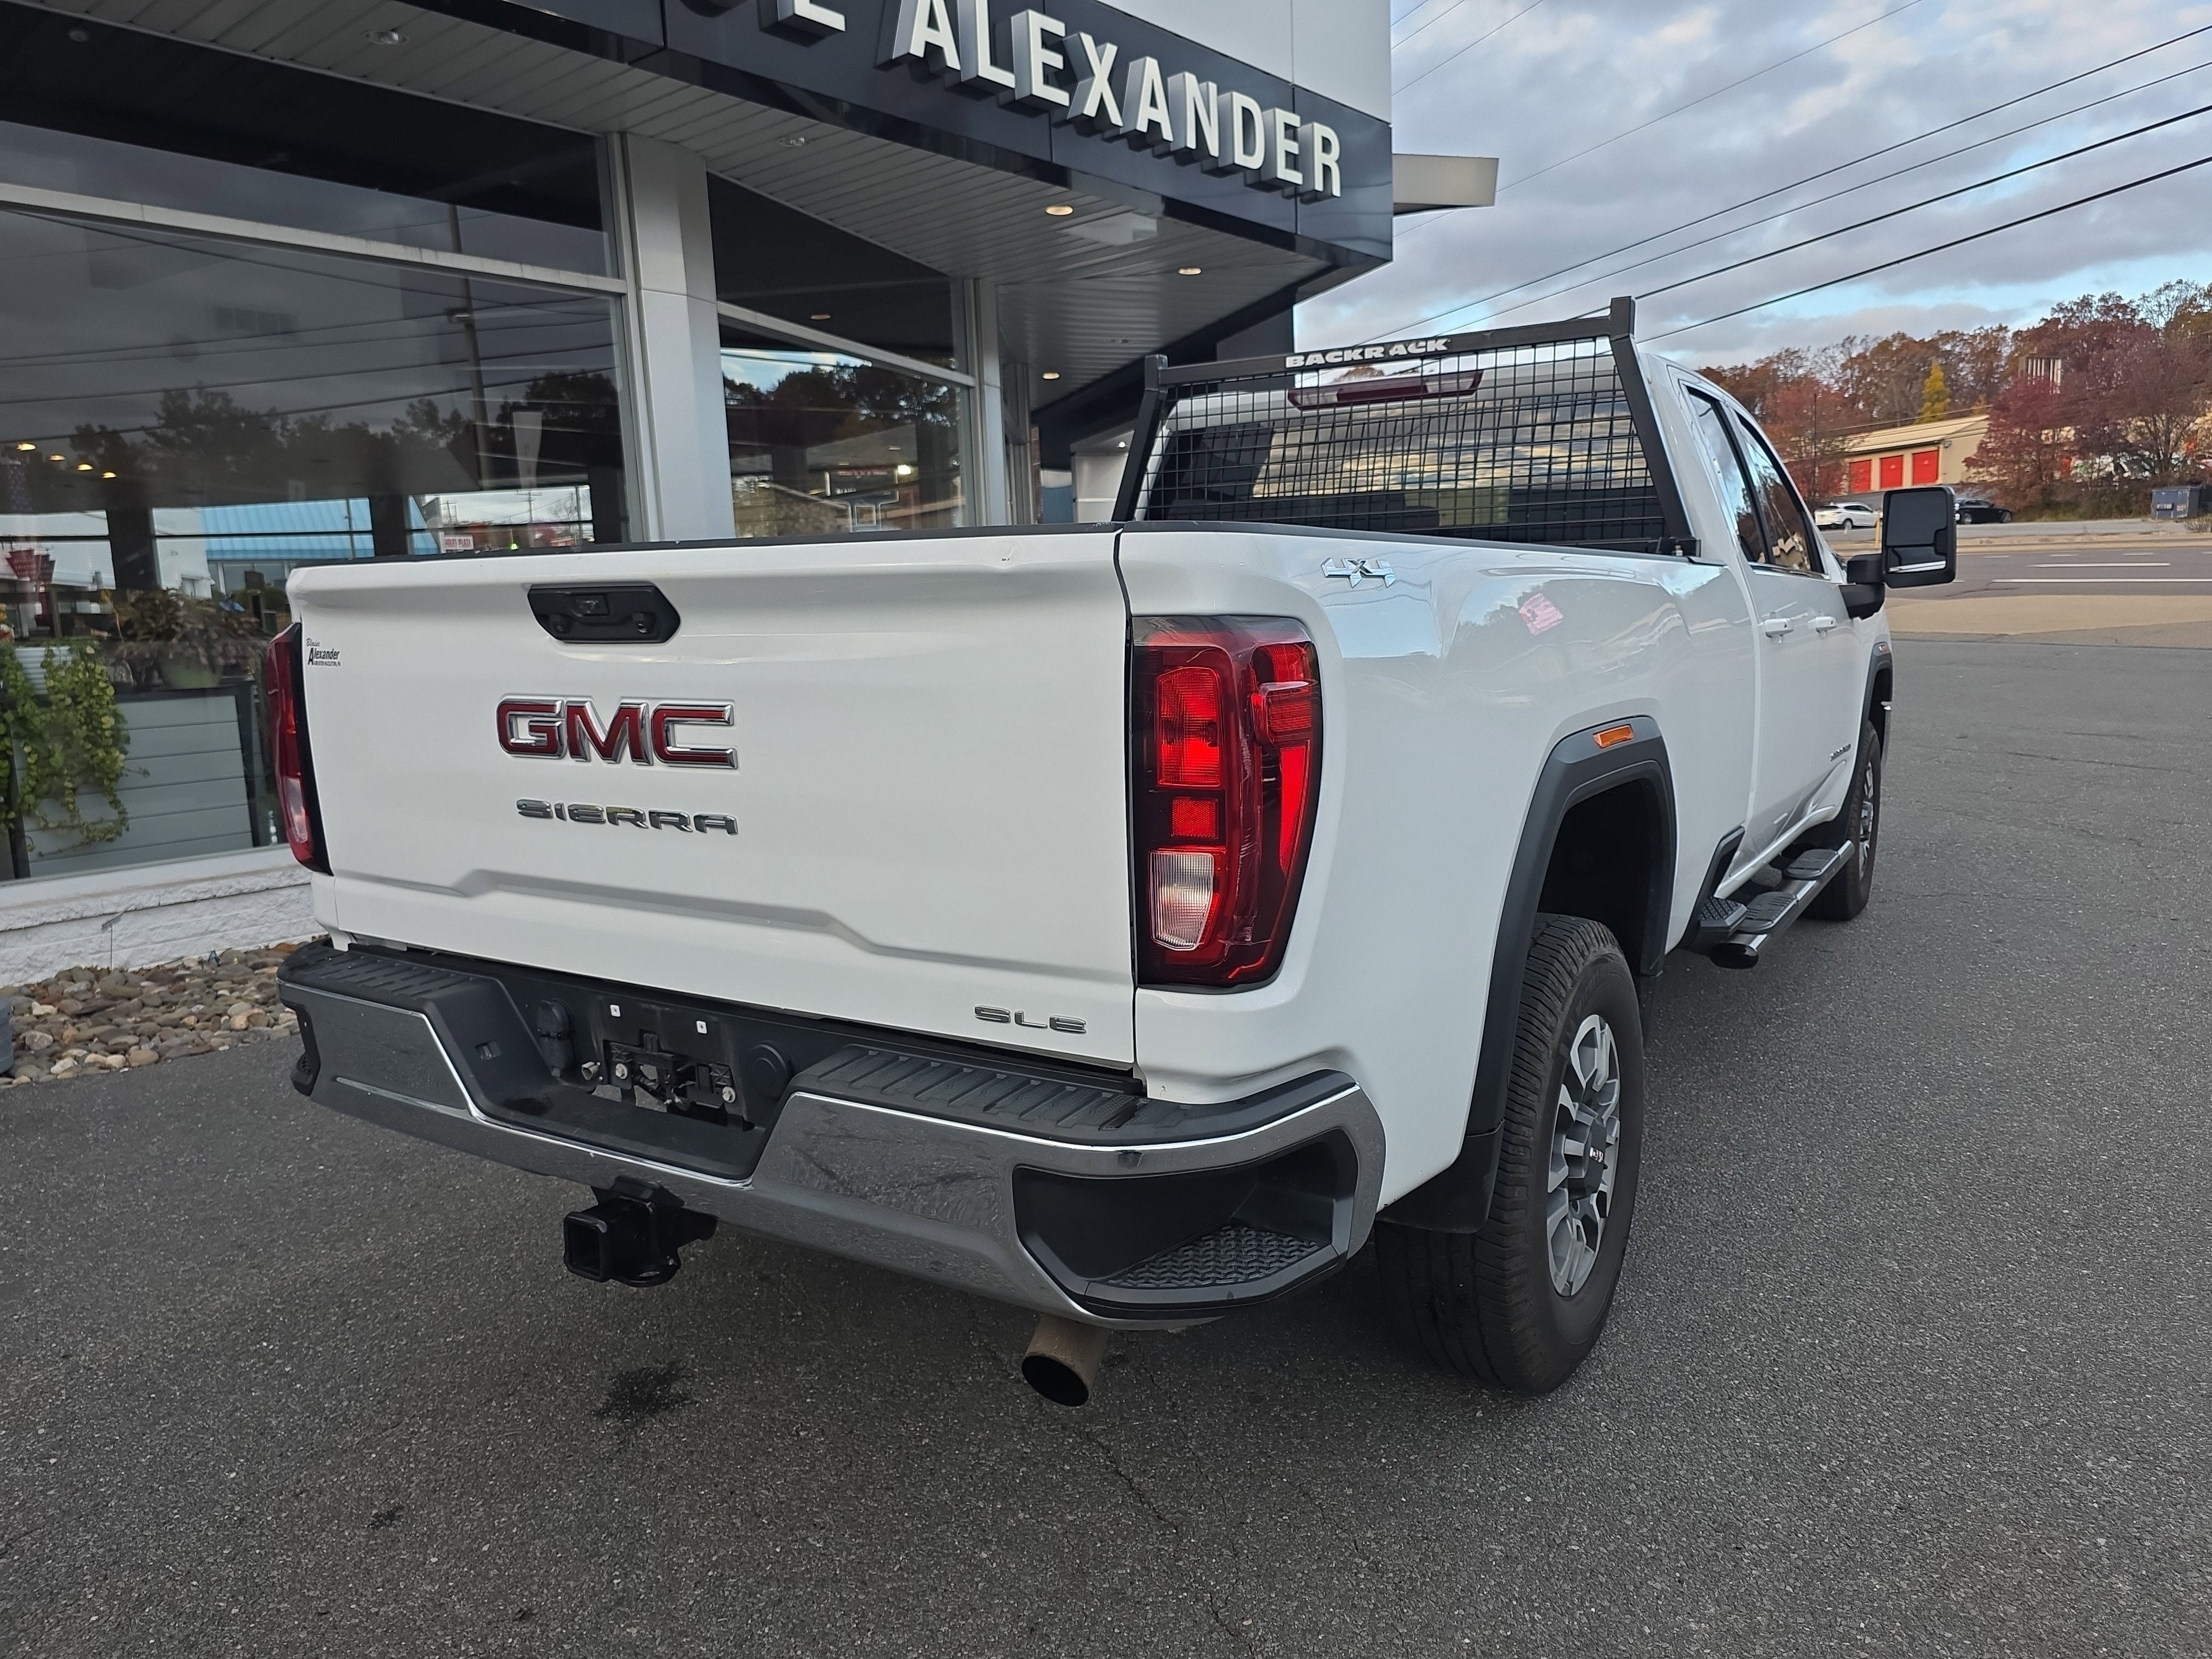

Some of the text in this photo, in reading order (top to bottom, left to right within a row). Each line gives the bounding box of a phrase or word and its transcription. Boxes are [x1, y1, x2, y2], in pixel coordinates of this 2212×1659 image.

[892, 0, 1341, 197] ALEXANDER
[1285, 338, 1448, 368] BACKRACK
[307, 647, 340, 665] Alexander
[497, 699, 738, 769] GMC
[516, 799, 738, 835] SIERRA
[975, 1005, 1086, 1034] SLE
